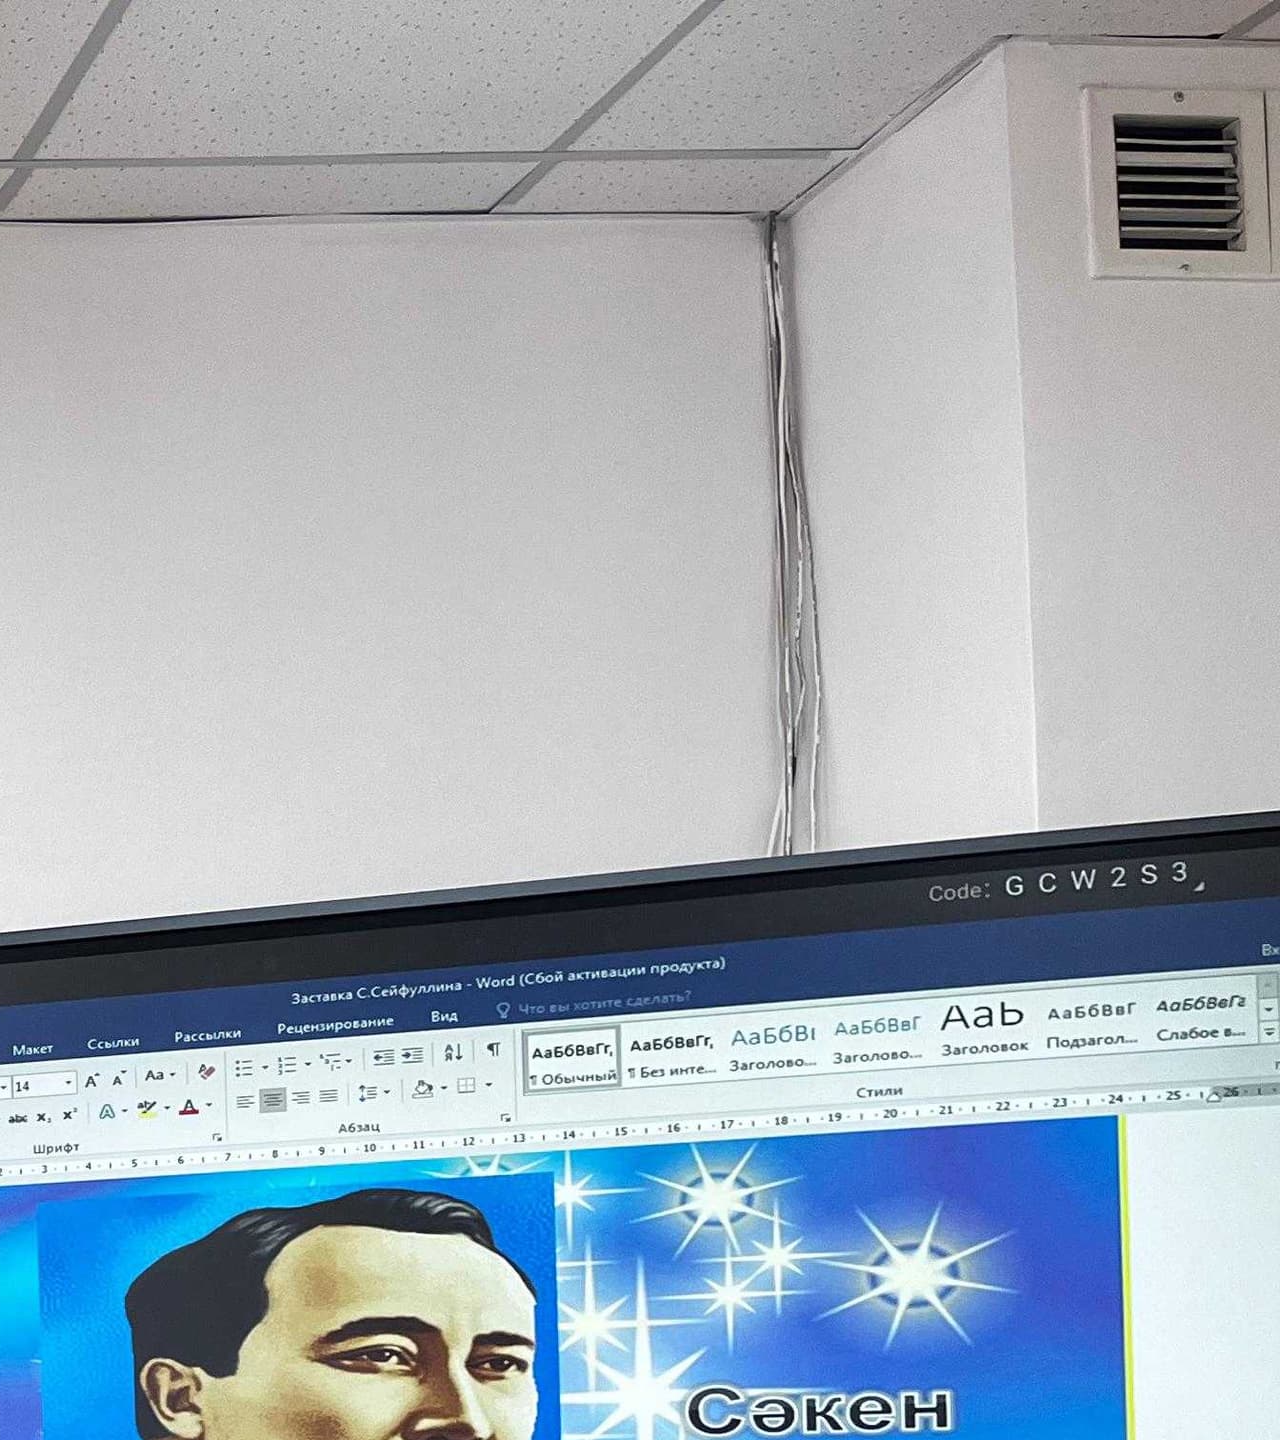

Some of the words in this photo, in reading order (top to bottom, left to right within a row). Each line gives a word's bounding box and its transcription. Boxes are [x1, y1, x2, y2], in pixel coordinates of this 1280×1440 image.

[928, 882, 991, 902] Code:
[1005, 875, 1024, 896] G
[1039, 873, 1057, 893] C
[1071, 869, 1097, 890] W
[1110, 866, 1127, 888] 2
[1141, 863, 1159, 885] S
[1172, 861, 1188, 882] 3
[291, 992, 353, 1005] Заставка
[356, 980, 462, 999] С.Сейфуллина
[476, 975, 515, 989] Word
[519, 970, 564, 988] (Сбой
[567, 966, 646, 982] активации
[650, 956, 726, 977] продукта)
[519, 1003, 546, 1016] Что
[549, 1001, 570, 1014] вы
[573, 997, 623, 1012] хотите
[626, 990, 693, 1009] сделать?
[12, 1044, 54, 1057] Макет
[87, 1036, 140, 1050] Ссылки
[175, 1028, 242, 1043] Рассылки
[277, 1015, 395, 1035] Рецензирование
[431, 1010, 459, 1024] Вид
[1157, 1027, 1220, 1042] Слабое
[942, 1040, 1030, 1057] Заголовок
[542, 1070, 617, 1086] Обычный
[640, 1065, 666, 1079] Без
[15, 1081, 30, 1092] 14
[856, 1086, 904, 1099] Стили
[338, 1121, 381, 1135] Абзац
[364, 1143, 376, 1153] 10
[413, 1140, 425, 1150] 11
[463, 1137, 475, 1147] 12
[513, 1133, 526, 1144] 13
[563, 1130, 576, 1141] 14
[615, 1127, 628, 1137] 15
[668, 1123, 681, 1133] 16
[721, 1119, 734, 1130] 17
[775, 1116, 789, 1126] 18
[829, 1112, 842, 1122] 19
[883, 1108, 898, 1119] 20
[939, 1105, 953, 1115] 21
[996, 1101, 1010, 1112] 22
[1053, 1098, 1068, 1108] 23
[1109, 1094, 1123, 1104] 24
[1166, 1091, 1181, 1101] 25
[1223, 1087, 1239, 1098] 26
[33, 1142, 80, 1157] Шрифт
[687, 1385, 953, 1437] Сәкен
